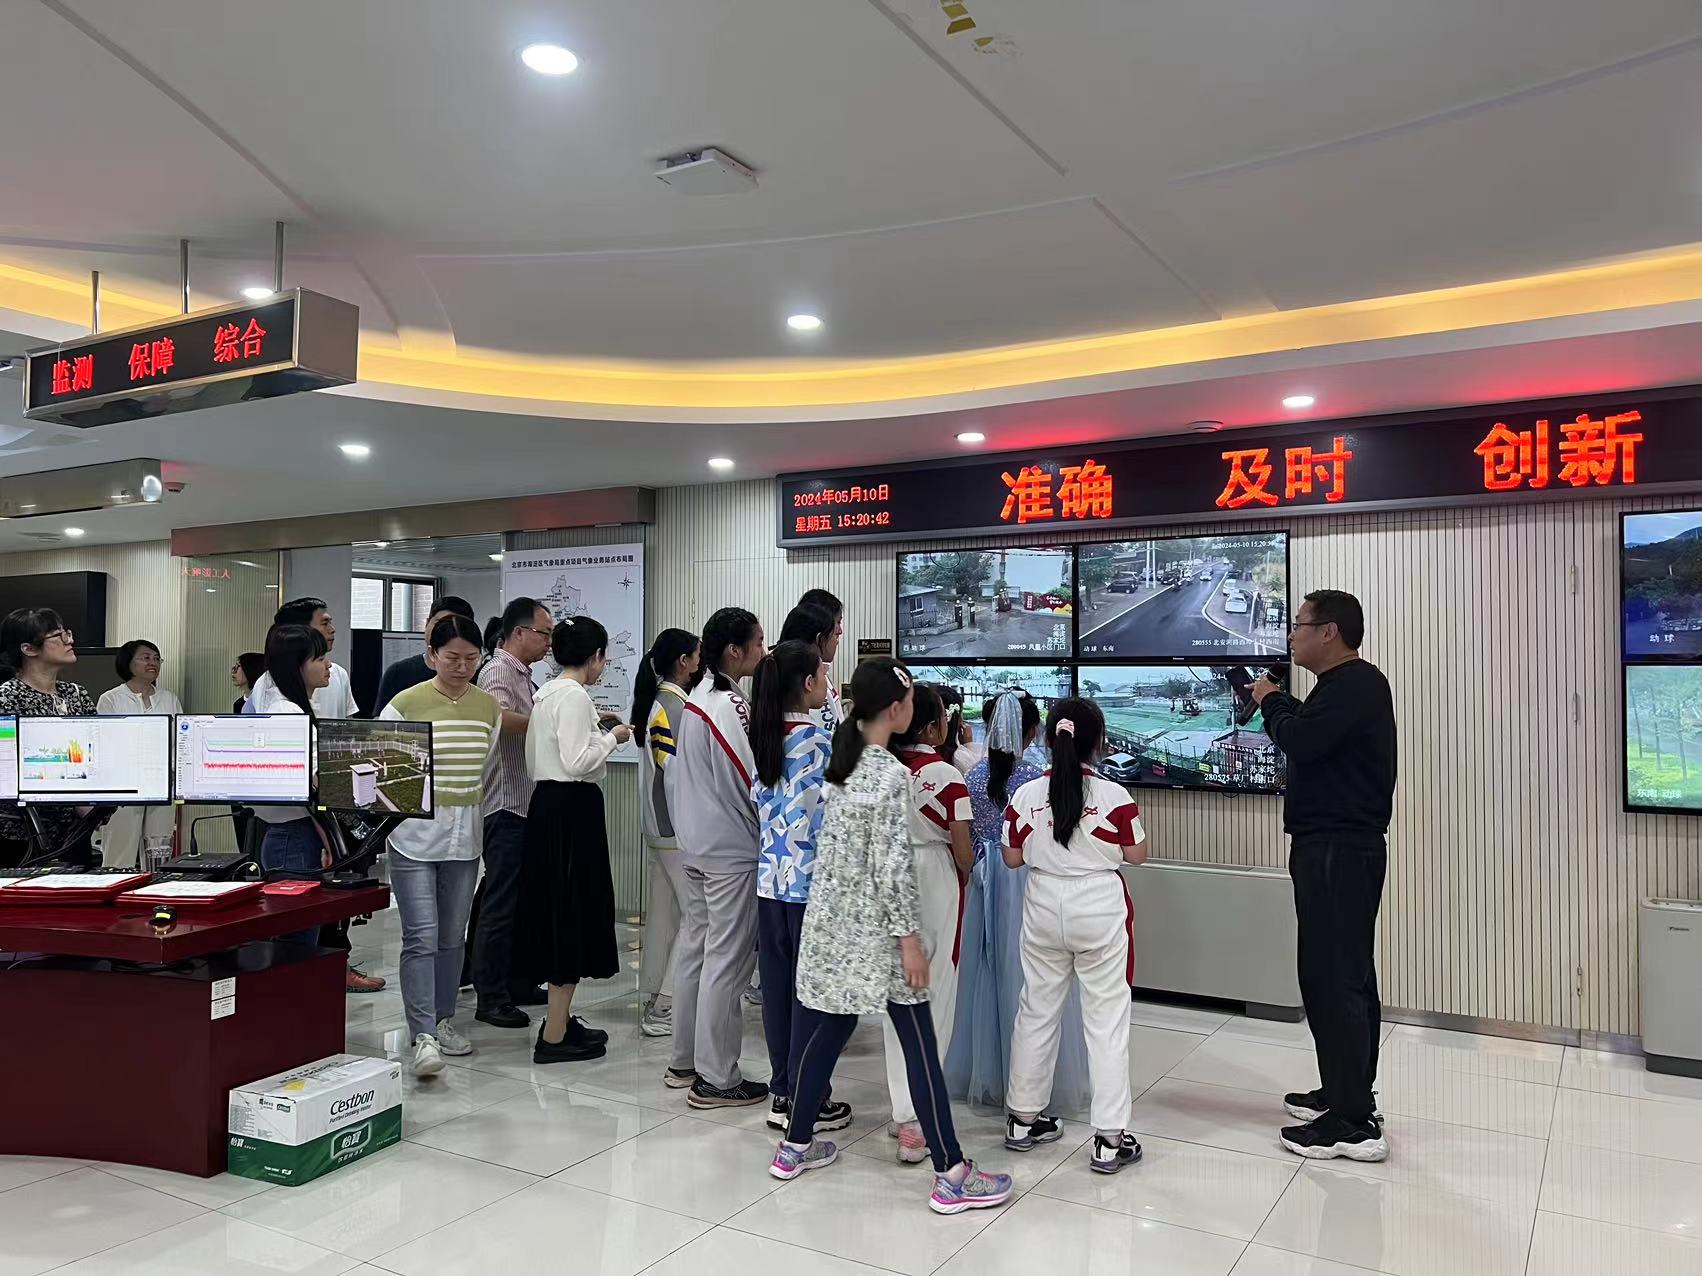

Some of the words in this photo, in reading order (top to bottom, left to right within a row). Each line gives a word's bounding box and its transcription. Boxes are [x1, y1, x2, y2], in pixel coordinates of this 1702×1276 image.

[51, 353, 94, 395] 监测
[128, 336, 175, 381] 保障
[213, 318, 266, 363] 综合
[1000, 459, 1113, 524] 准确
[1215, 437, 1353, 508] 及时
[1474, 410, 1643, 490] 创新
[794, 484, 889, 507] 2024年05月10日
[795, 514, 832, 532] 星期五
[837, 511, 890, 528] 15:20:42
[1259, 744, 1275, 754] 北京
[330, 1090, 375, 1115] C'estbon
